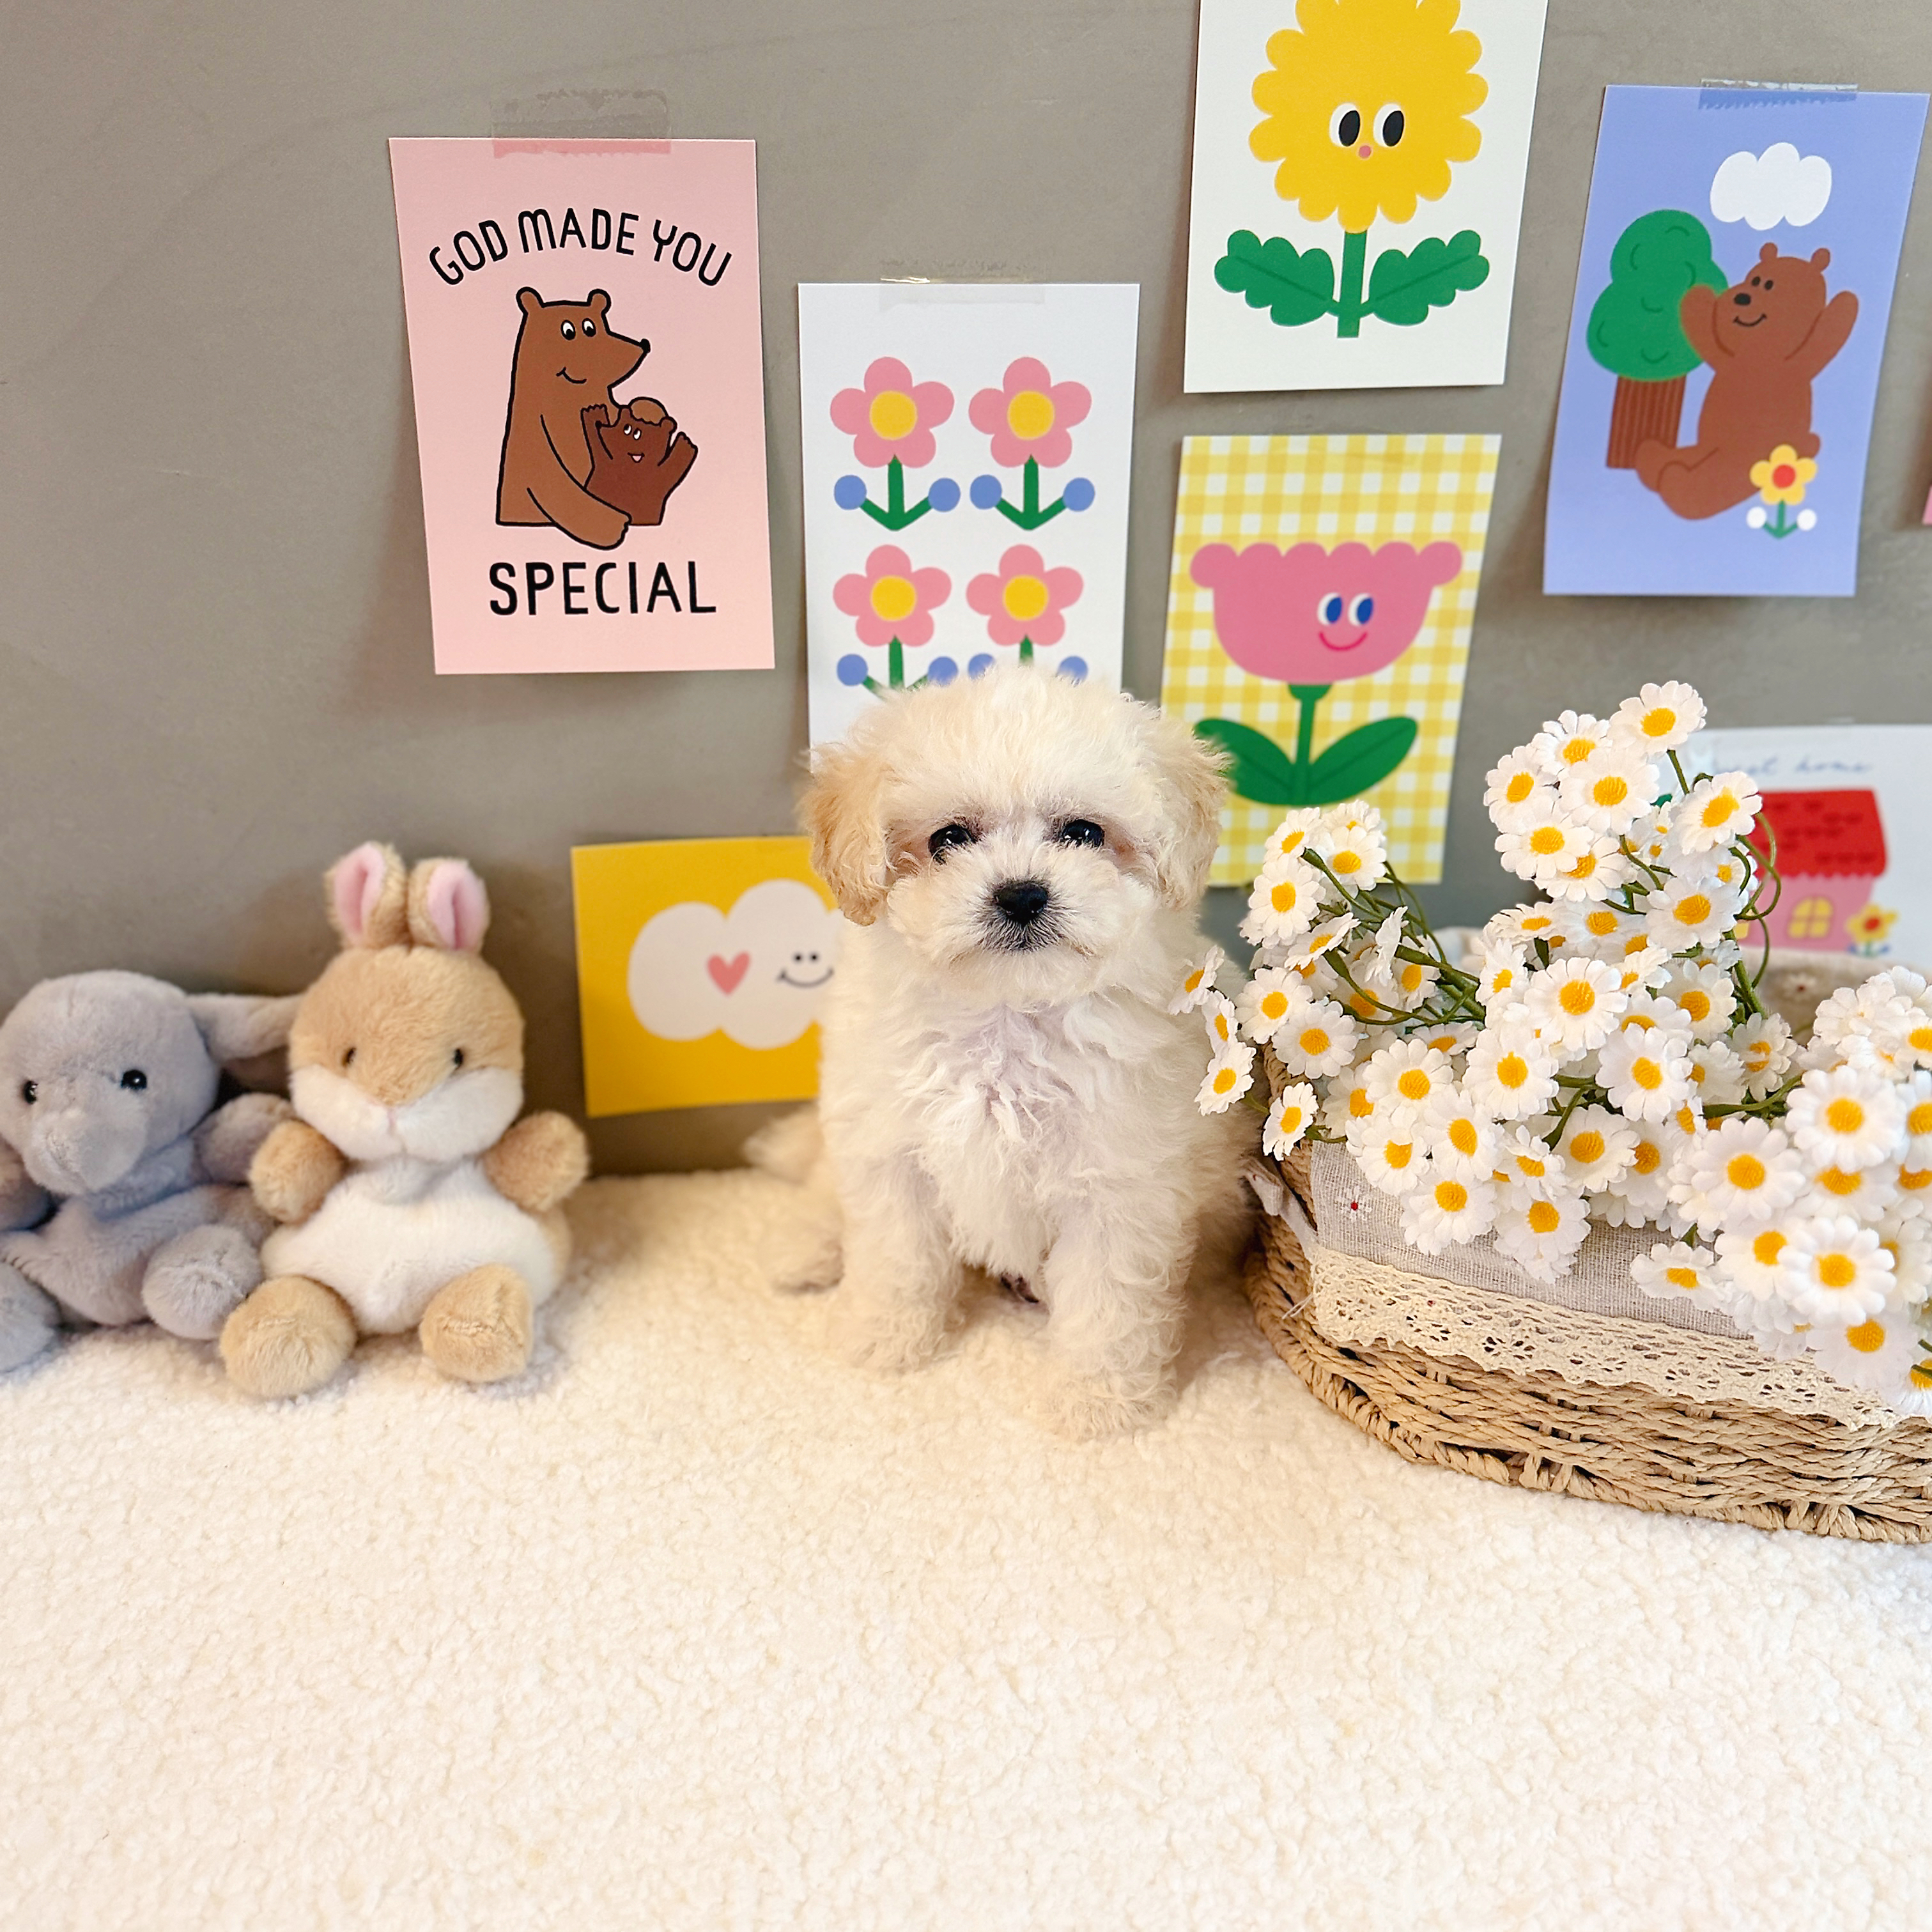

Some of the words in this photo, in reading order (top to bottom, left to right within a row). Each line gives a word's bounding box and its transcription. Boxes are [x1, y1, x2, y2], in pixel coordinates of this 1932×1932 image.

[429, 220, 508, 285] GOD
[518, 208, 639, 256] MADE
[653, 219, 732, 286] YOU
[490, 560, 716, 615] SPECIAL
